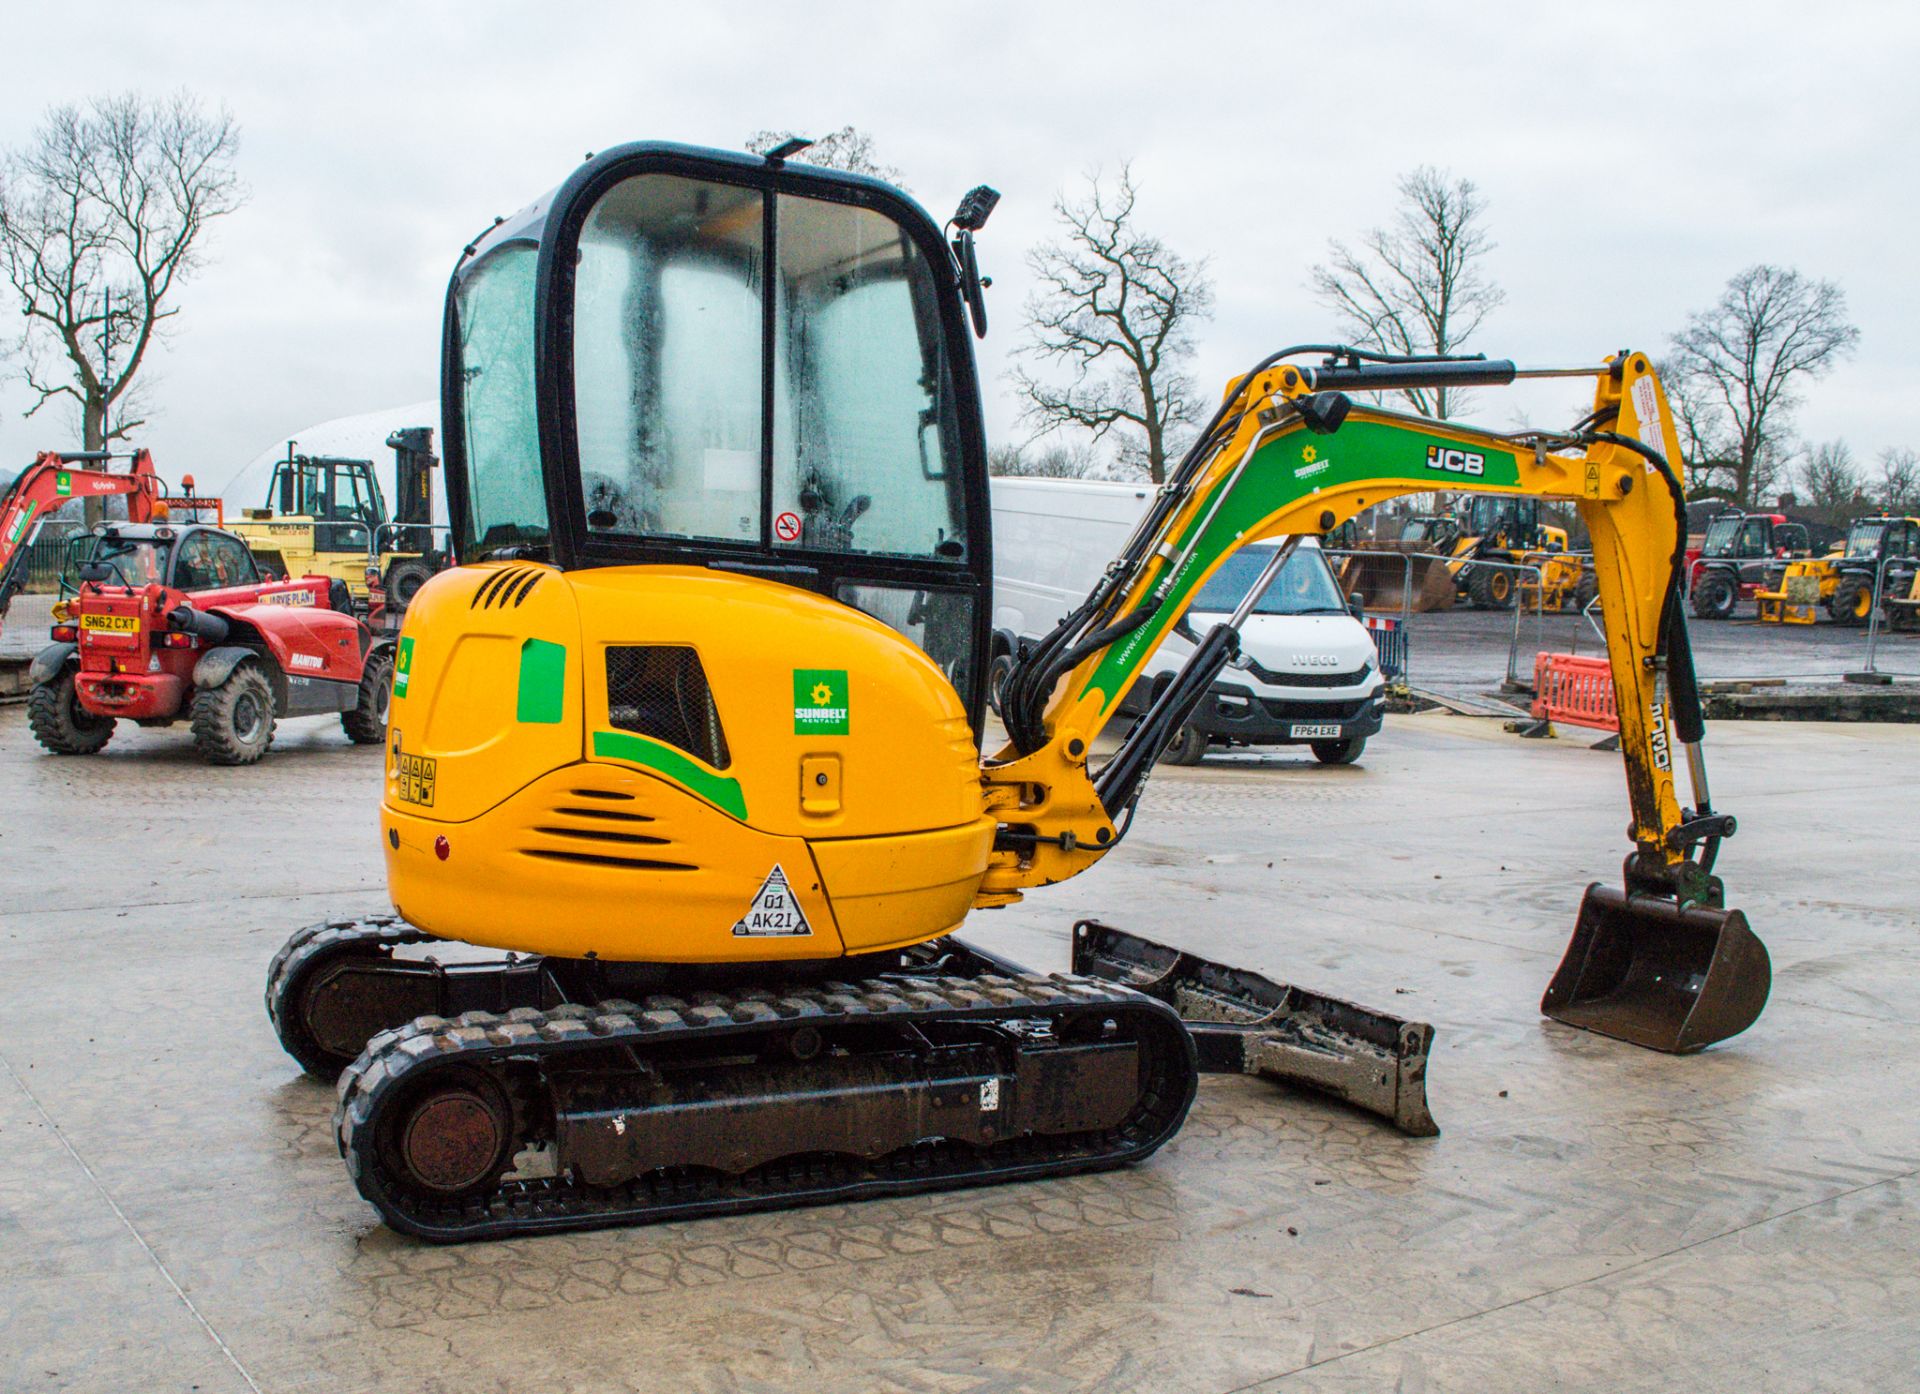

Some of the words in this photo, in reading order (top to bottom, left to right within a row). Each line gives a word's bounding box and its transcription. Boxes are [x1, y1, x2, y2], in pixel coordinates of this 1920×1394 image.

[1427, 447, 1484, 475] JCB
[84, 615, 112, 629] SN62
[114, 617, 136, 630] CXT
[1291, 654, 1339, 667] IVECO
[795, 708, 847, 719] SUNBELT
[1294, 726, 1318, 736] FP64
[1320, 726, 1338, 736] EXE
